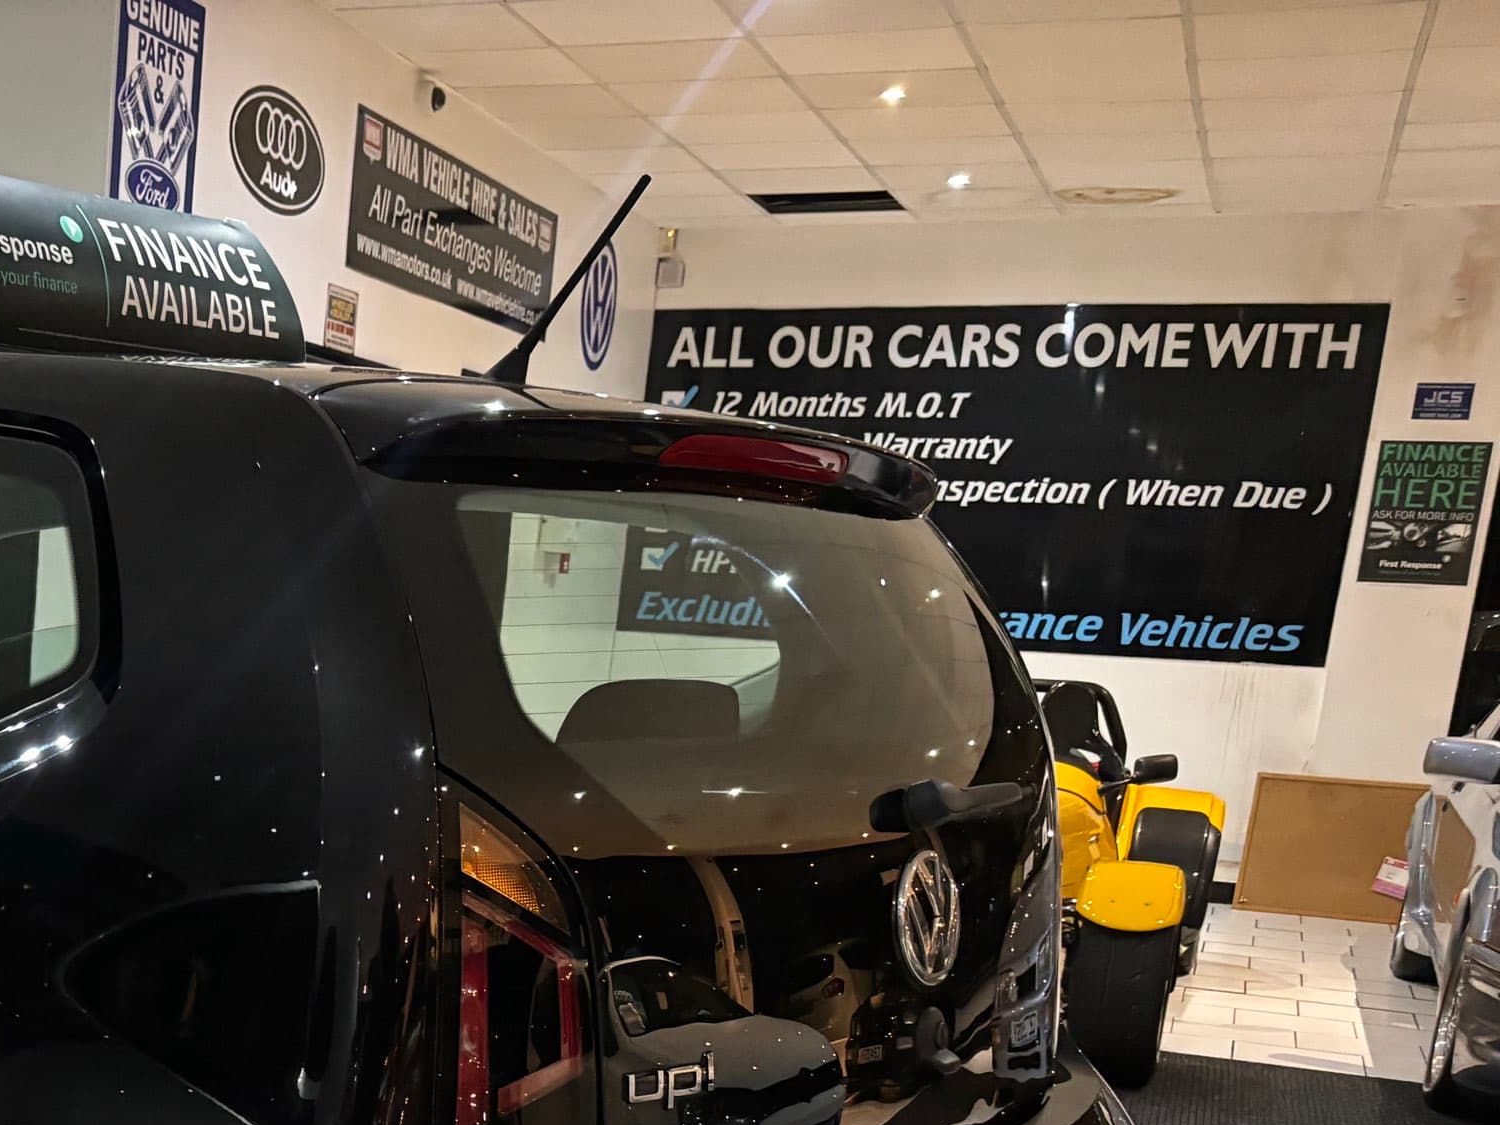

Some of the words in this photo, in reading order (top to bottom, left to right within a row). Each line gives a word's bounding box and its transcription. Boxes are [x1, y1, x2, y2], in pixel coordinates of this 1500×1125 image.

[126, 0, 200, 51] GENUINE
[137, 31, 186, 81] PARTS
[154, 75, 164, 104] &
[135, 169, 171, 209] Ford
[260, 161, 298, 199] Audi
[386, 126, 419, 184] WMA
[423, 147, 471, 210] VEHICLE
[470, 176, 498, 225] HIRE
[498, 193, 507, 231] &
[508, 199, 539, 248] SALES
[97, 217, 272, 291] FINANCE
[368, 184, 391, 225] All
[392, 194, 423, 241] Part
[424, 209, 492, 275] Exchanges
[494, 244, 542, 296] Welcome
[0, 270, 30, 288] your
[33, 272, 78, 295] finance
[121, 275, 280, 340] AVAILABLE
[666, 326, 754, 368] ALL
[768, 325, 874, 368] OUR
[887, 324, 1022, 368] CARS
[1035, 323, 1195, 368] COME
[1203, 323, 1363, 369] WITH
[712, 391, 743, 416] 12
[748, 390, 867, 418] Months
[874, 391, 972, 419] M.O.T
[1423, 391, 1465, 404] JCS
[863, 431, 1014, 465] Warranty
[1381, 443, 1485, 464] FINANCE
[1380, 462, 1483, 479] AVAILABLE
[935, 478, 1092, 507] nspection
[1125, 479, 1224, 508] When
[1232, 481, 1307, 510] Due
[1373, 478, 1480, 510] HERE
[1372, 510, 1394, 520] ASK
[1394, 511, 1416, 521] FOR
[1417, 511, 1448, 521] MORE
[1449, 512, 1475, 522] INFO
[1379, 559, 1398, 569] First
[1400, 560, 1443, 570] Response
[999, 611, 1104, 642] ance
[1119, 612, 1306, 651] Vehicles
[626, 1052, 715, 1109] up!
